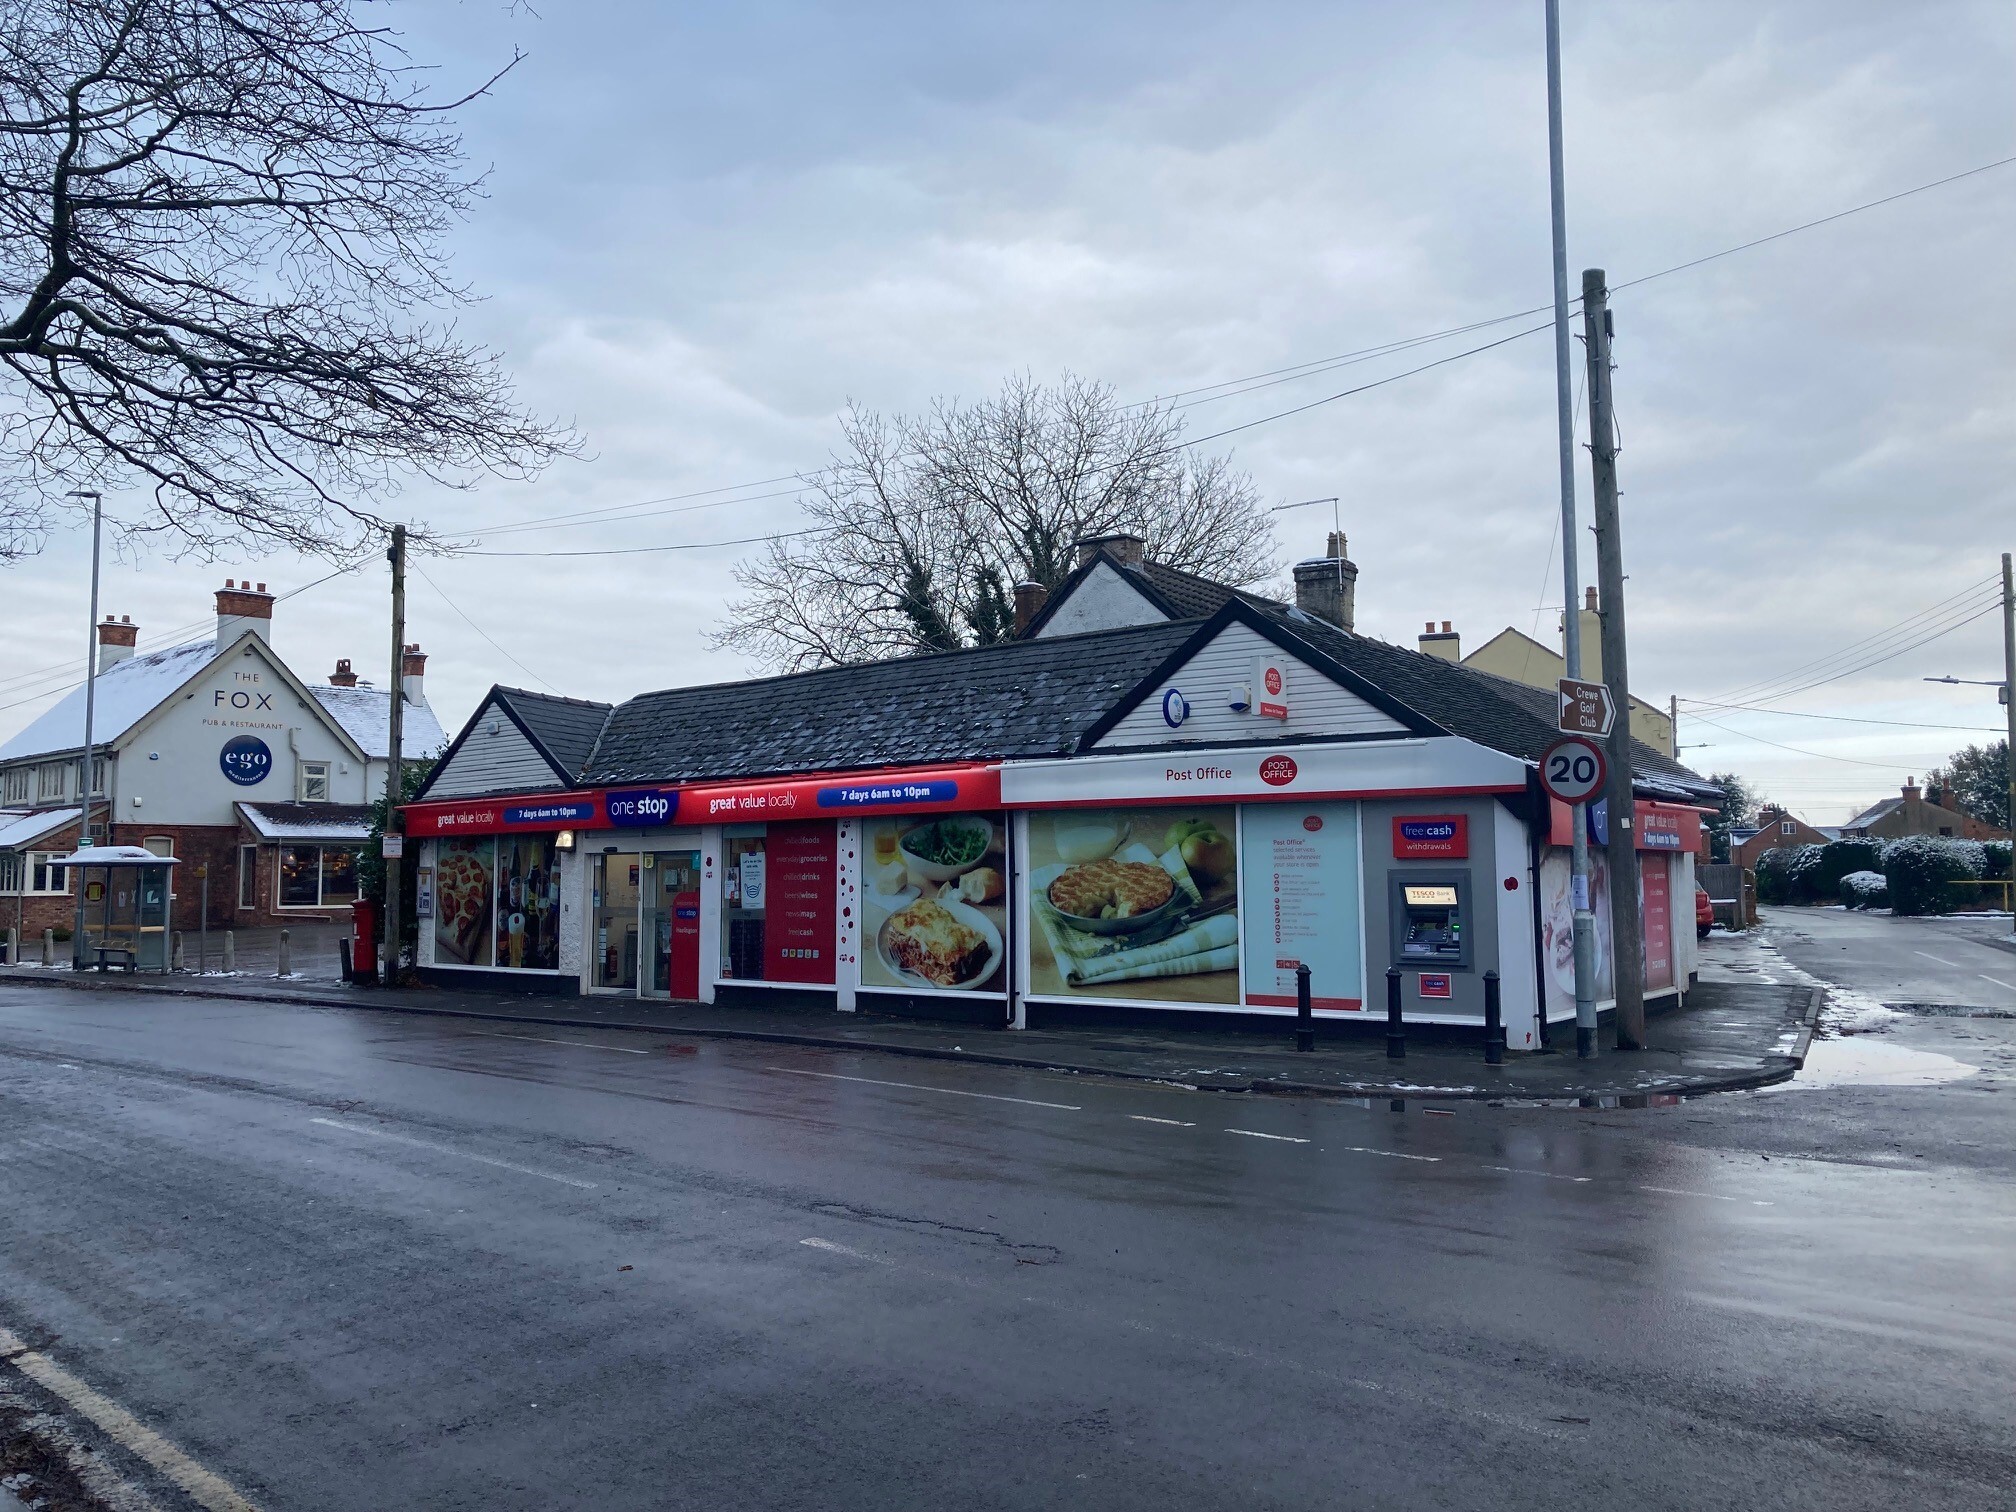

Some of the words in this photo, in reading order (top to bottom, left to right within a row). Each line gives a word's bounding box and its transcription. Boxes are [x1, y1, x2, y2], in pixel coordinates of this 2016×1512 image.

[233, 672, 259, 682] THE
[1268, 673, 1278, 681] POST
[1266, 680, 1280, 689] OFFICE
[1576, 686, 1599, 700] Crewe
[214, 690, 272, 711] FOX
[1580, 701, 1596, 714] Golf
[230, 720, 284, 730] RESTAURANT
[1580, 715, 1597, 728] Club
[225, 752, 267, 770] ego
[1267, 761, 1290, 770] POST
[1166, 768, 1193, 781] Post
[1196, 767, 1232, 780] Office
[1262, 769, 1293, 779] OFFICE
[1550, 755, 1596, 784] 20
[841, 790, 847, 801] 7
[849, 789, 869, 803] days
[870, 788, 889, 800] 6am
[891, 787, 902, 798] to
[903, 786, 930, 799] 10pm
[611, 800, 634, 816] one
[637, 796, 668, 818] stop
[709, 794, 736, 814] great
[739, 793, 766, 809] value
[768, 791, 798, 810] locally
[437, 811, 455, 828] great
[456, 811, 474, 824] value
[474, 810, 495, 824] locally
[518, 810, 523, 819] 7
[523, 809, 538, 820] days
[538, 808, 551, 818] 6am
[551, 808, 559, 817] to
[559, 807, 577, 818] 10pm
[1644, 814, 1656, 830] great
[1656, 814, 1667, 828] value
[1405, 825, 1424, 836] free
[1426, 825, 1452, 835] cash
[802, 836, 820, 844] foods
[800, 854, 828, 864] groceries
[783, 873, 801, 881] chilled
[801, 873, 820, 881] drinks
[784, 891, 799, 899] beers
[800, 891, 818, 899] wines
[800, 910, 817, 919] mags
[788, 928, 799, 936] free
[799, 928, 814, 936] cash
